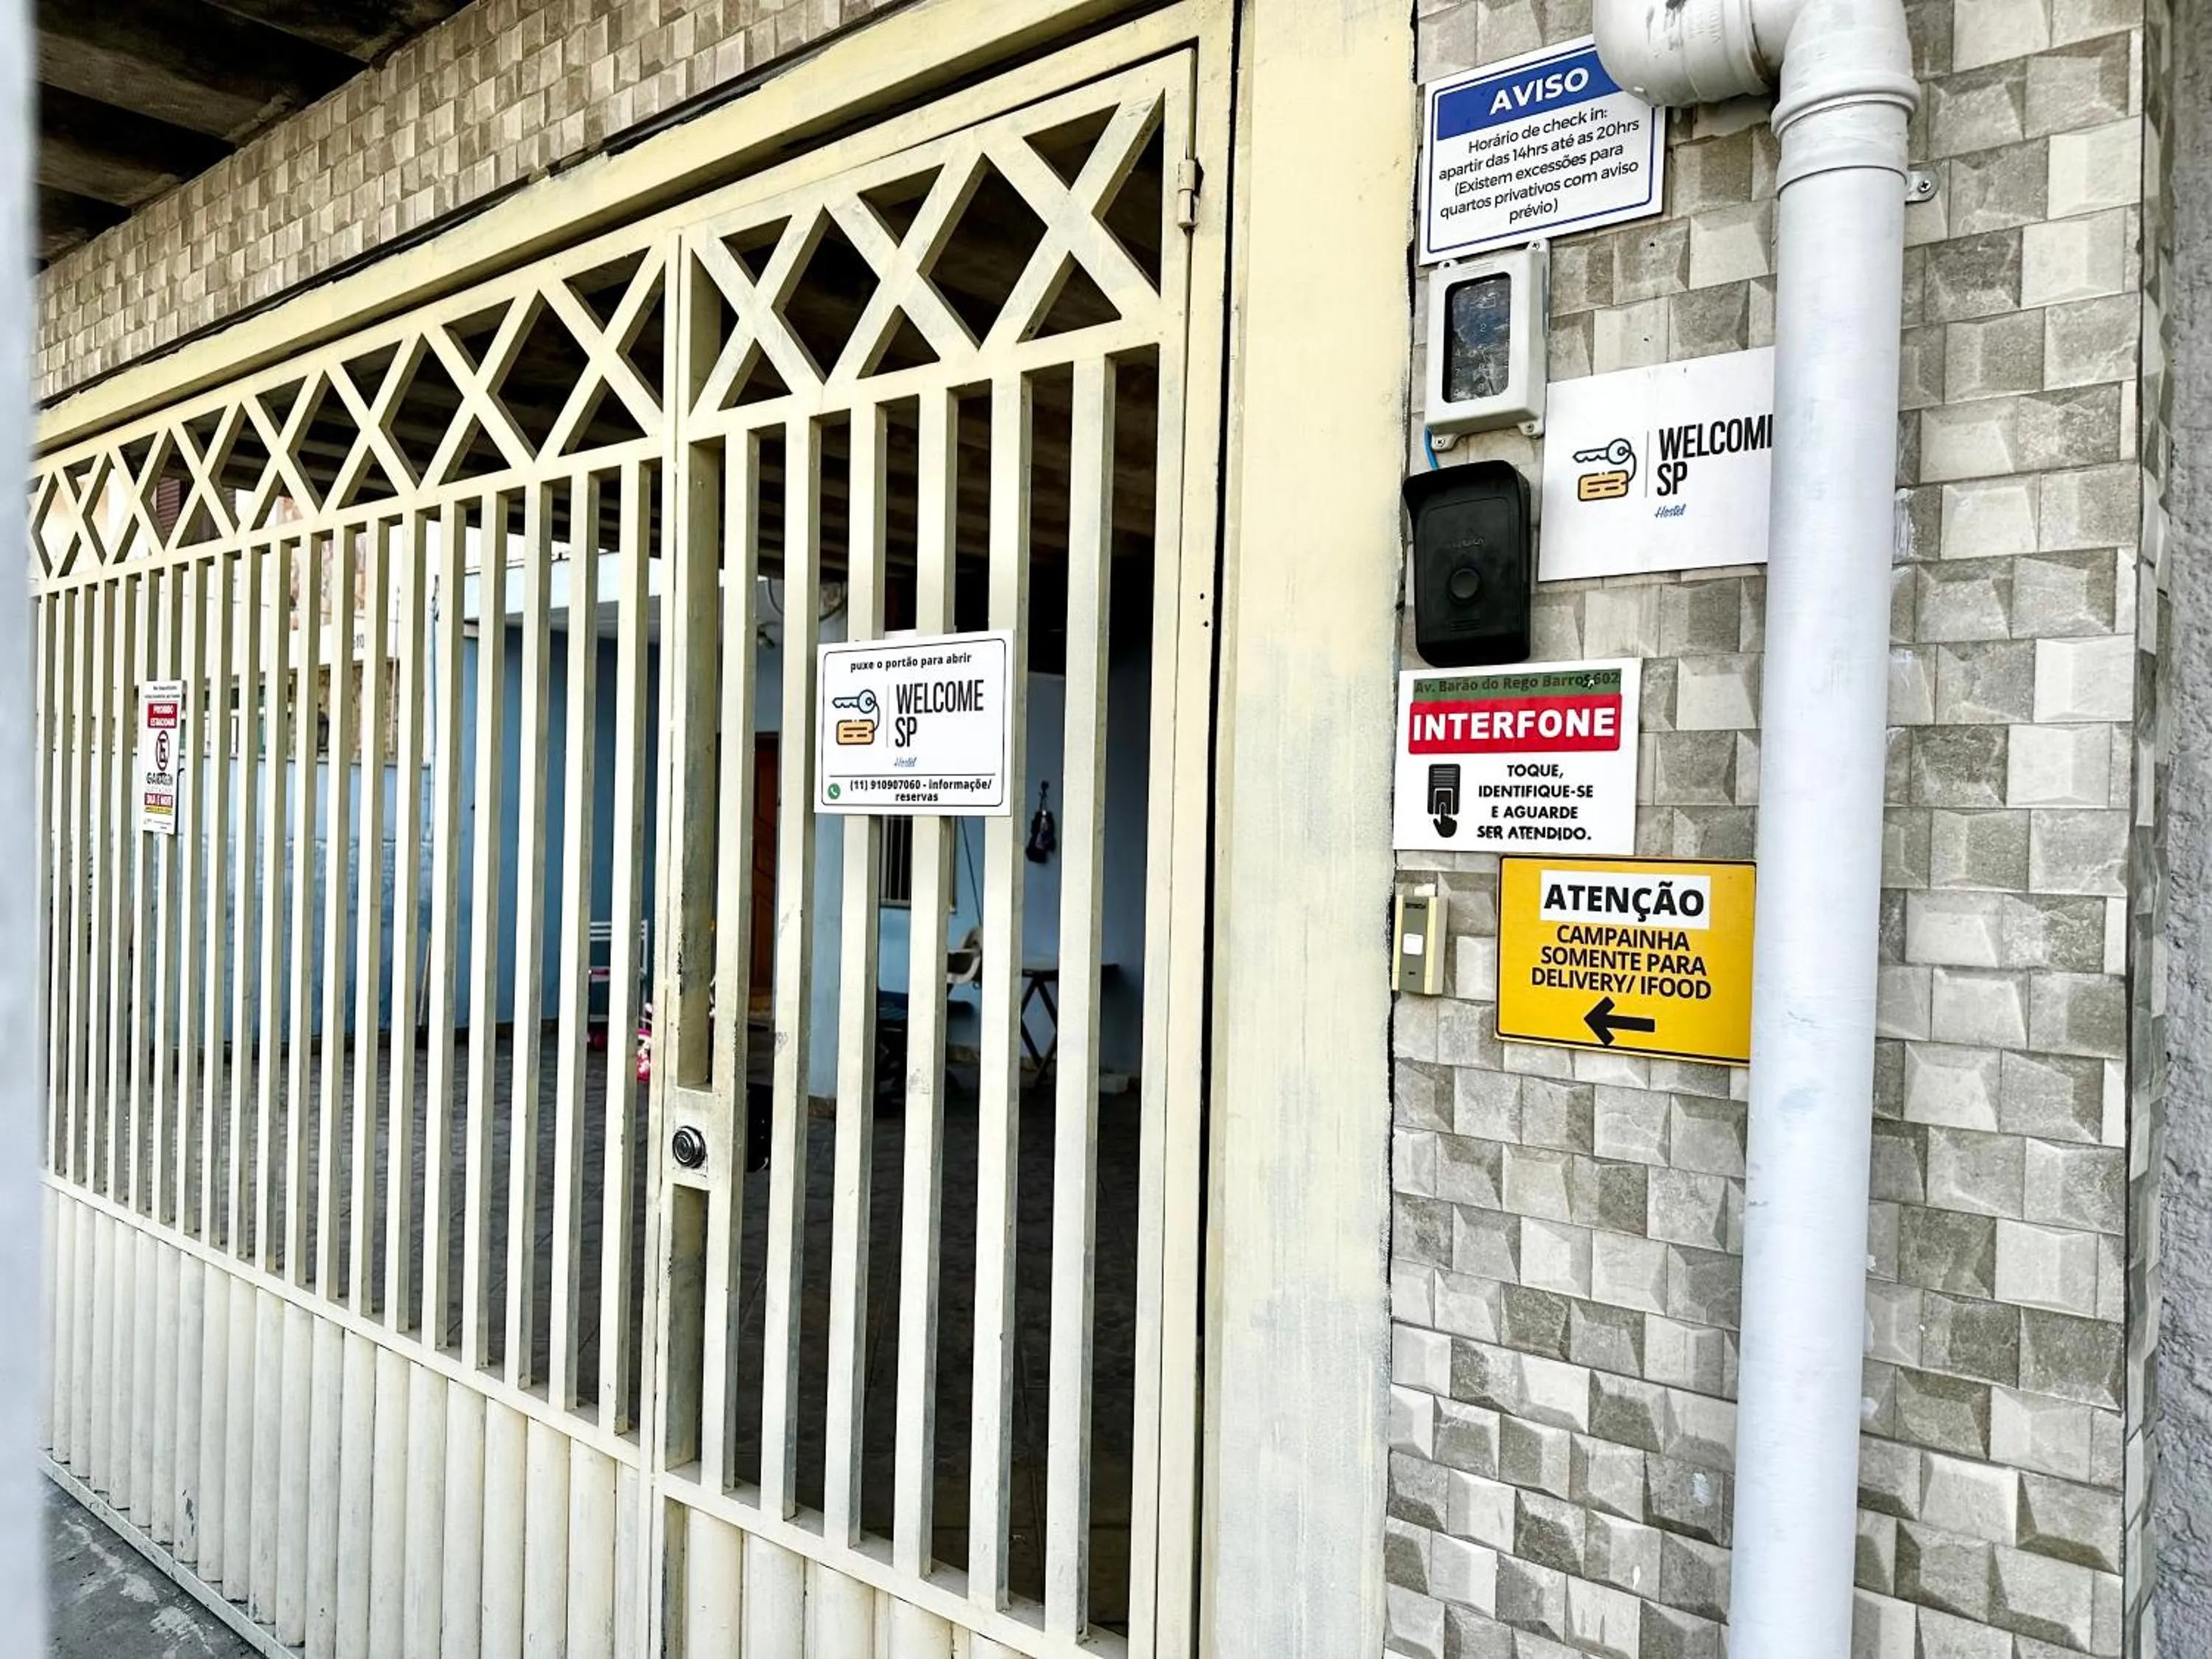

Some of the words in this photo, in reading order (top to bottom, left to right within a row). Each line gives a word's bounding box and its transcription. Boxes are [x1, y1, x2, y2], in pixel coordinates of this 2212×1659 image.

[1489, 68, 1589, 115] AVISO
[1468, 131, 1519, 153] Horário
[1522, 125, 1540, 139] de
[1543, 112, 1587, 133] check
[1590, 108, 1607, 120] in:
[1439, 159, 1484, 181] apartir
[1486, 152, 1510, 167] das
[1513, 143, 1548, 162] 14hrs
[1551, 135, 1574, 152] até
[1577, 132, 1593, 145] as
[1597, 119, 1639, 139] 20hrs
[1455, 173, 1512, 196] (Existem
[1516, 155, 1586, 179] excessões
[1590, 145, 1624, 165] para
[1440, 198, 1491, 218] quartos
[1495, 181, 1560, 204] privativos
[1564, 173, 1597, 189] com
[1601, 161, 1638, 181] aviso
[1509, 198, 1558, 224] prévio)
[1657, 461, 1688, 496] SP
[1655, 503, 1687, 518] Hostel
[850, 661, 874, 672] puxe
[886, 656, 918, 671] portão
[921, 656, 943, 668] para
[946, 653, 972, 664] abrir
[896, 679, 984, 714] WELCOME
[1415, 681, 1435, 693] Av.
[1439, 678, 1478, 692] Barão
[1482, 678, 1498, 689] do
[1503, 678, 1538, 692] Rego
[894, 716, 917, 748] SP
[1413, 707, 1615, 740] INTERFONE
[850, 780, 868, 791] (11)
[871, 779, 921, 790] 910907060
[1507, 764, 1564, 779] TOQUE,
[895, 793, 939, 801] reservas
[1478, 785, 1593, 799] IDENTIFIQUE-SE
[1492, 807, 1498, 818] E
[1503, 807, 1579, 819] AGUARDE
[1477, 826, 1503, 840] SER
[1509, 827, 1592, 841] ATENDIDO.
[1543, 881, 1705, 922] ATENÇÃO
[1557, 925, 1690, 951] CAMPAINHA
[1540, 947, 1641, 971] SOMENTE
[1646, 953, 1707, 975] PARA
[1531, 967, 1634, 995] DELIVERY/
[1641, 976, 1711, 1000] IFOOD
